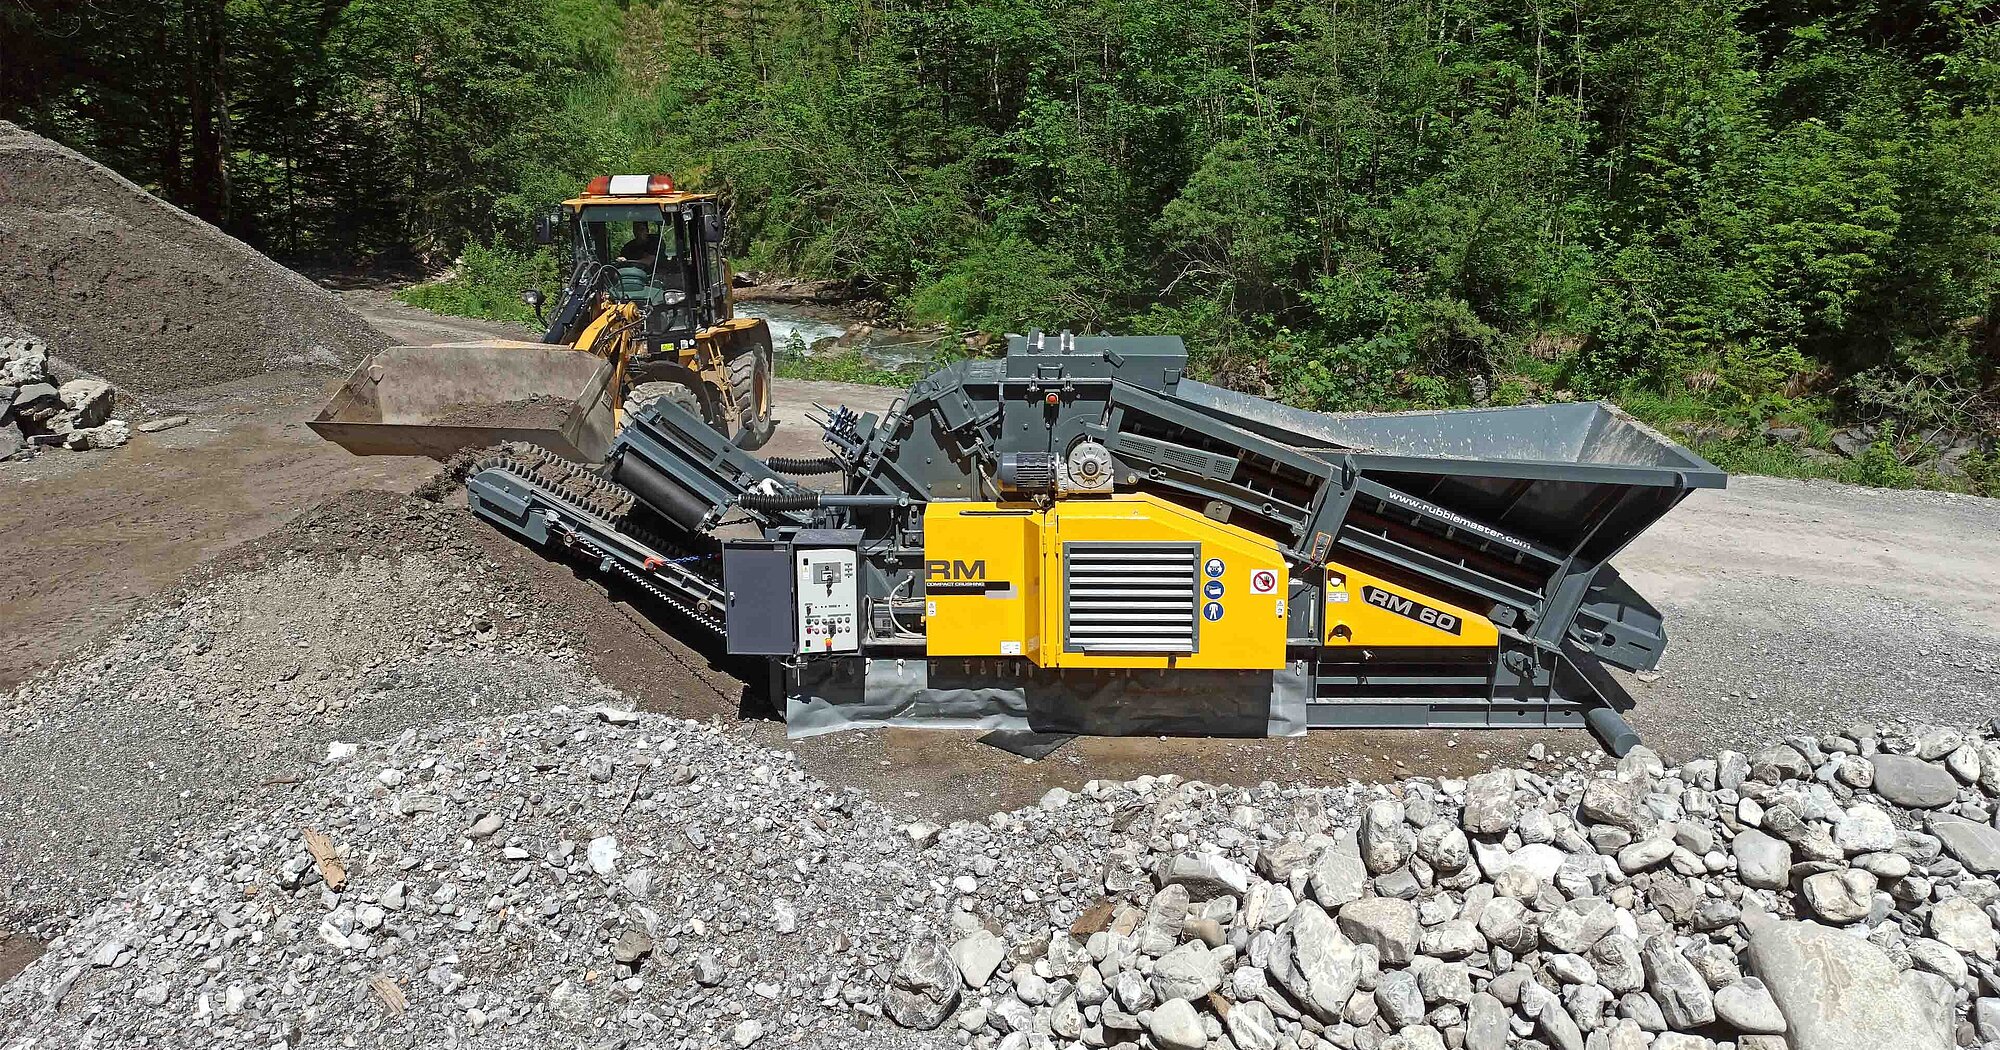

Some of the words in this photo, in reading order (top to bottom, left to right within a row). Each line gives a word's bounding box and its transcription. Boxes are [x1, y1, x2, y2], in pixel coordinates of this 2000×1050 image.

[1389, 491, 1531, 550] www.rubblemaster.com
[926, 560, 985, 579] RM
[1368, 588, 1414, 615] RM
[1419, 607, 1456, 630] 60
